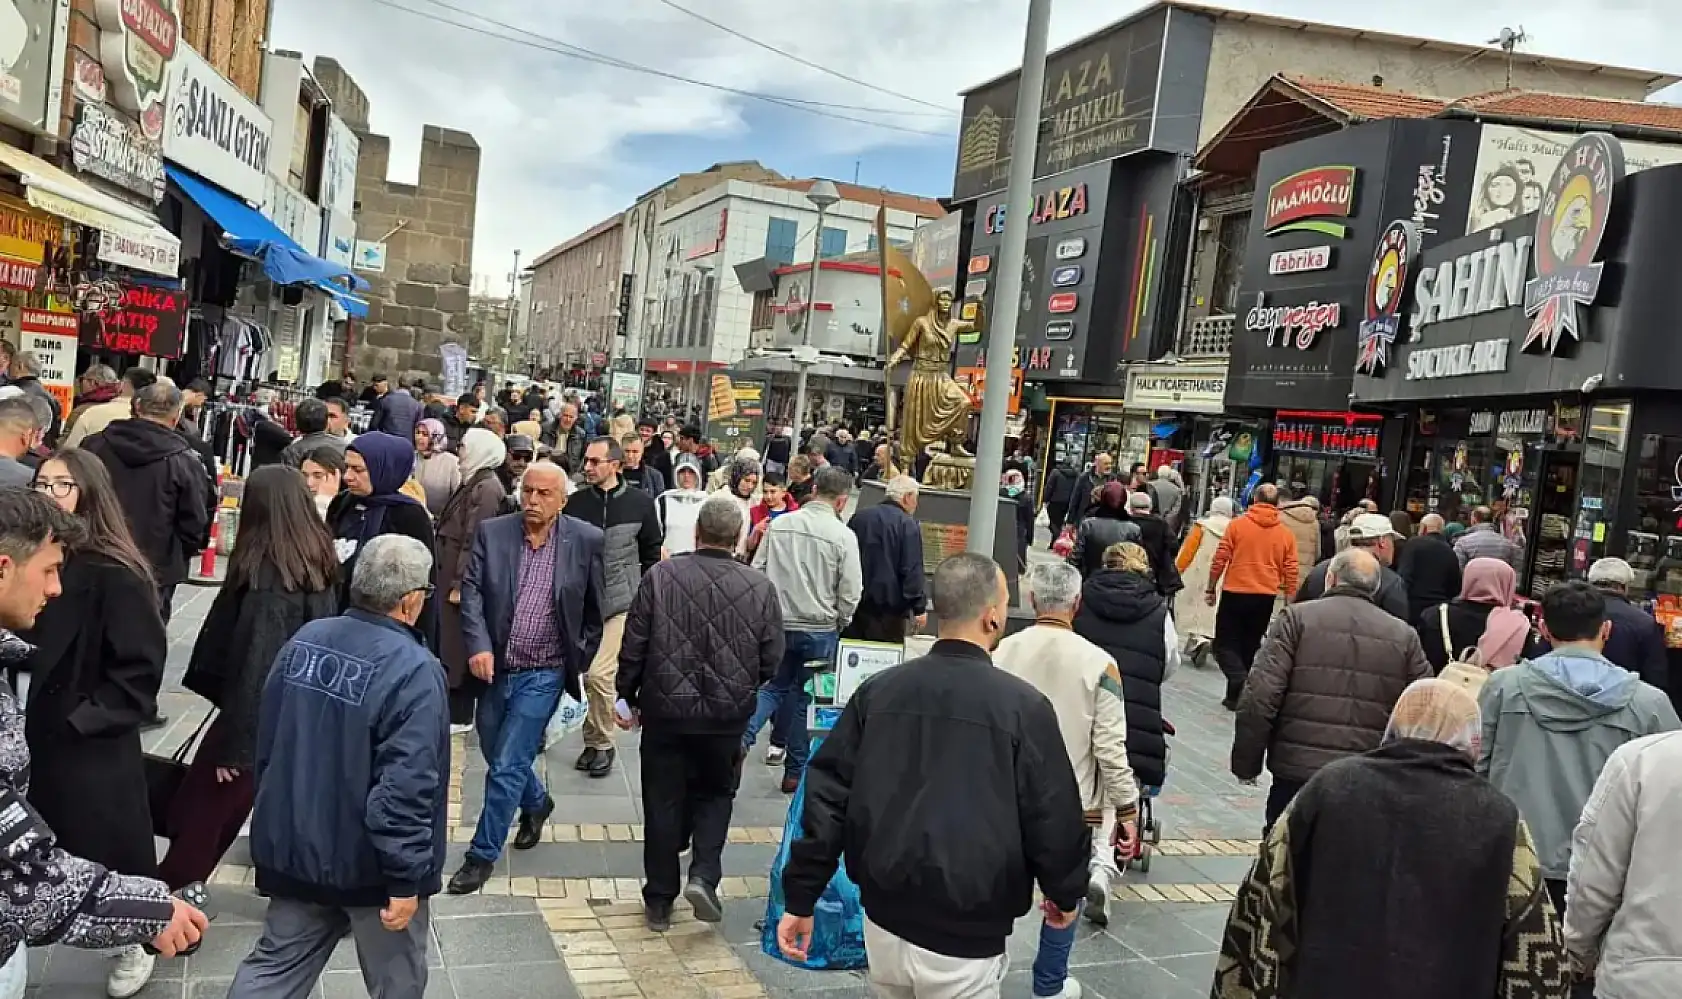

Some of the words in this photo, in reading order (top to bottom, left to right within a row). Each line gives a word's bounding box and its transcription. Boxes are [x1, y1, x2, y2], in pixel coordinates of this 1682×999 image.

[1043, 52, 1112, 109] LAZA
[186, 77, 235, 153] ŞANLI
[1028, 182, 1087, 225] LAZA
[1275, 249, 1324, 272] fabrika
[1410, 229, 1533, 342] ŞAHİN
[1136, 379, 1157, 391] HALK
[284, 645, 361, 699] DIOR
